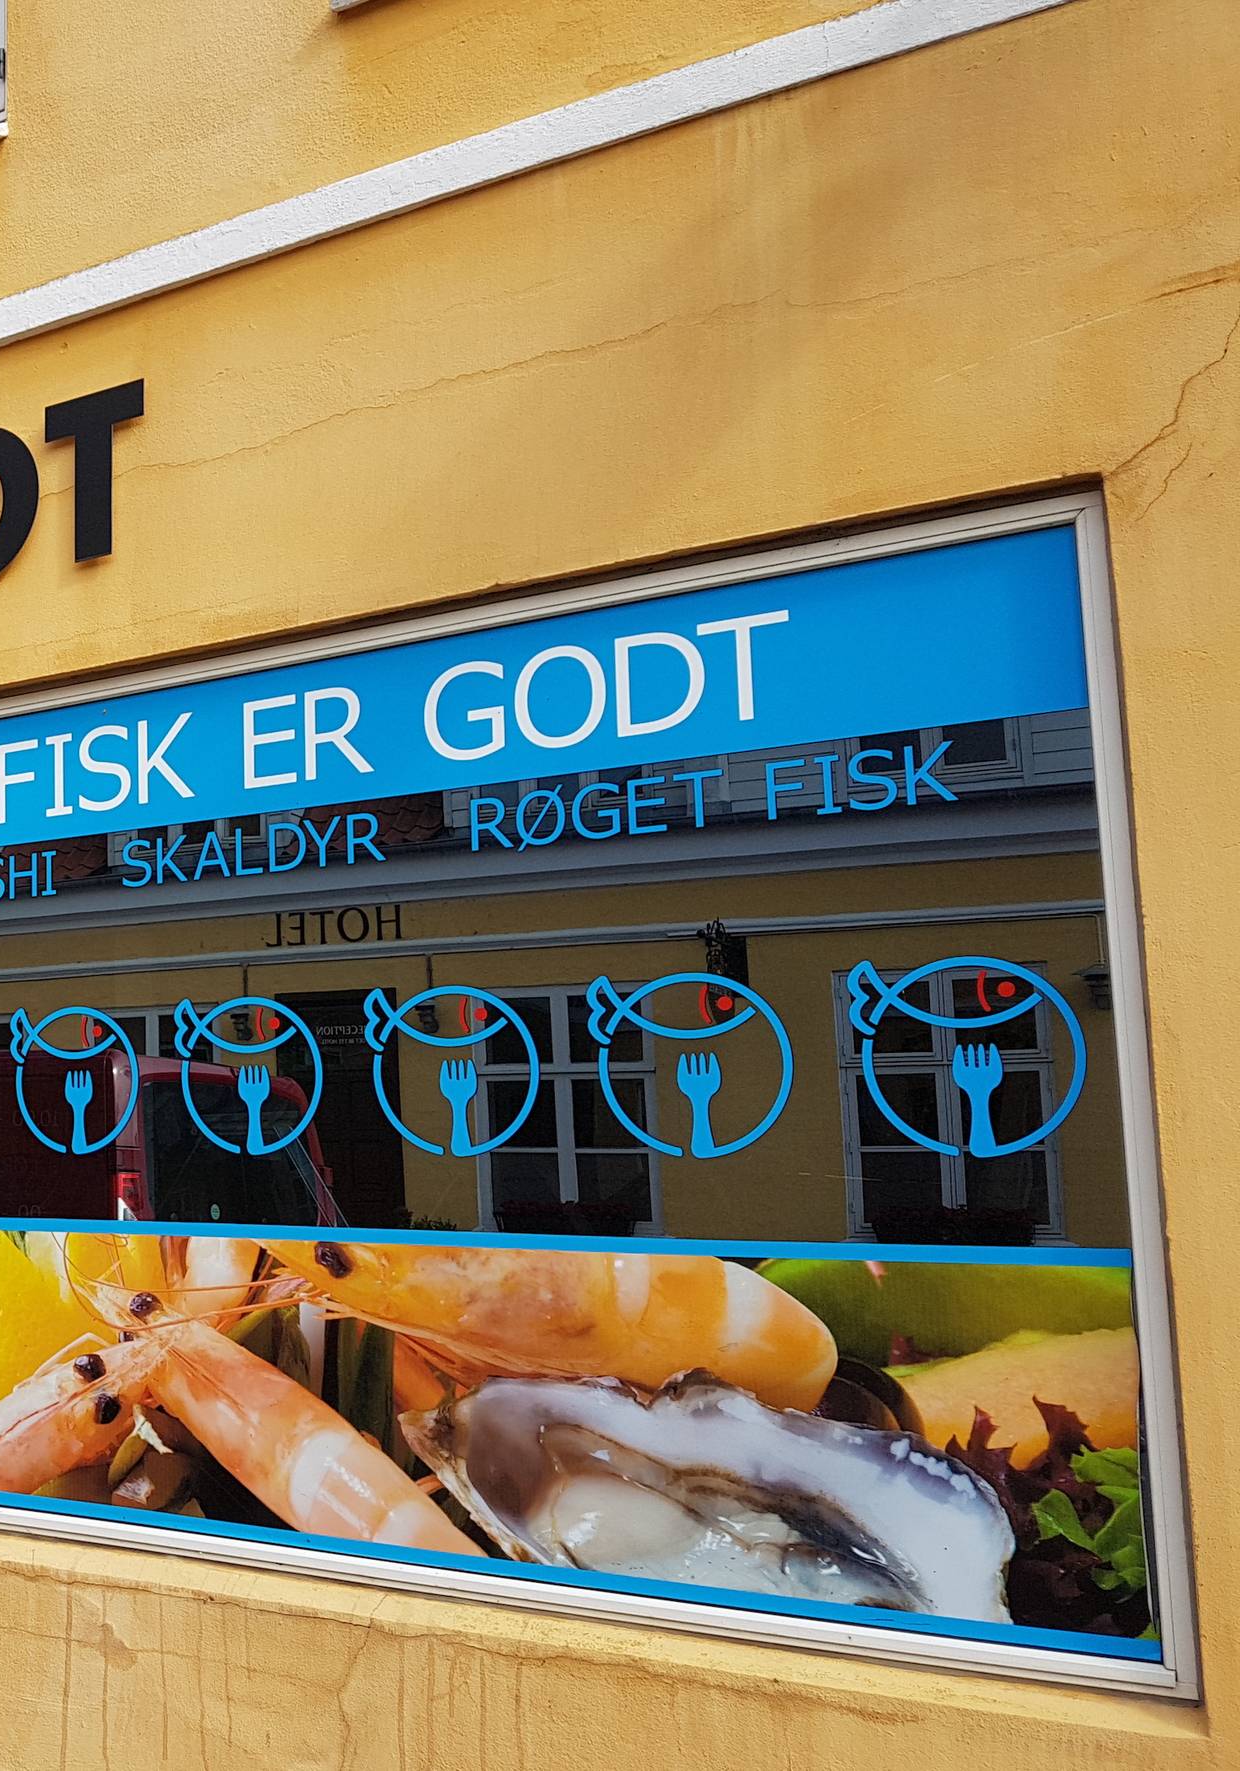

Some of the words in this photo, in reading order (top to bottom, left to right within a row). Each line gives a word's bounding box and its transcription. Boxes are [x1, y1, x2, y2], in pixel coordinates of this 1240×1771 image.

[243, 686, 375, 790] ER
[424, 609, 790, 762] GODT
[121, 812, 387, 888] SKALDYR
[470, 768, 723, 853] RØGET
[765, 740, 959, 821] FISK
